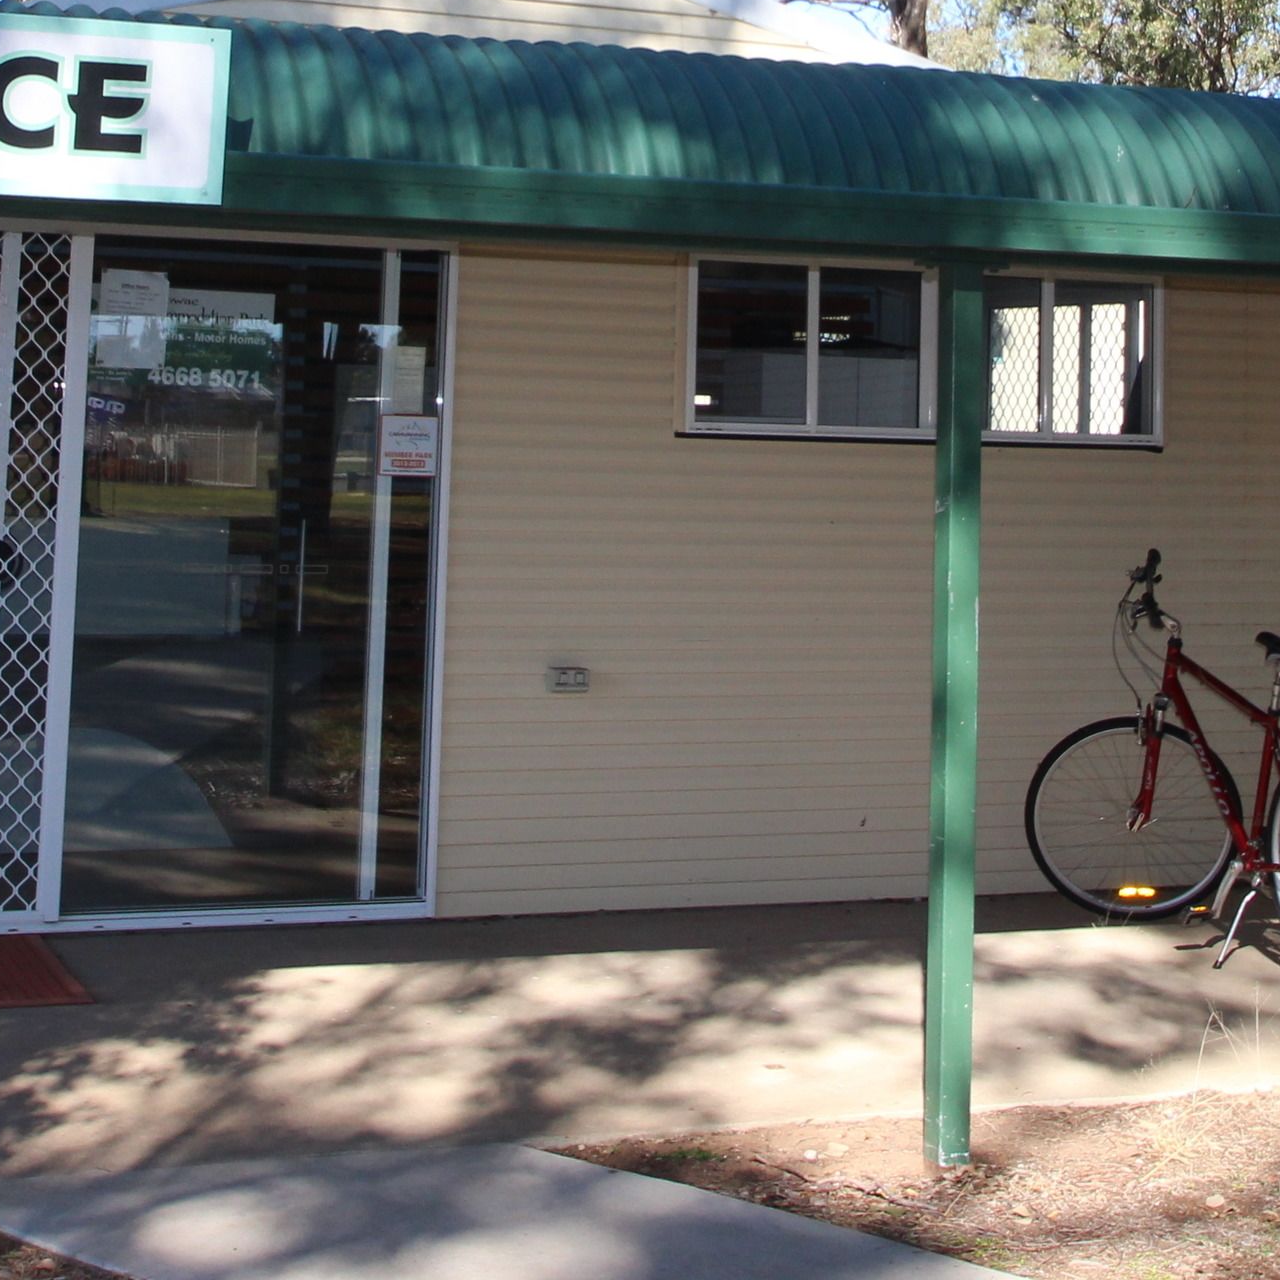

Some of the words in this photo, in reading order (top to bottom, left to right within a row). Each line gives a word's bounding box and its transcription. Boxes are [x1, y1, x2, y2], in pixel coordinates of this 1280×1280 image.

[194, 332, 226, 343] Motor
[229, 333, 267, 345] Homes
[148, 367, 202, 387] 4668
[208, 369, 260, 390] 5071
